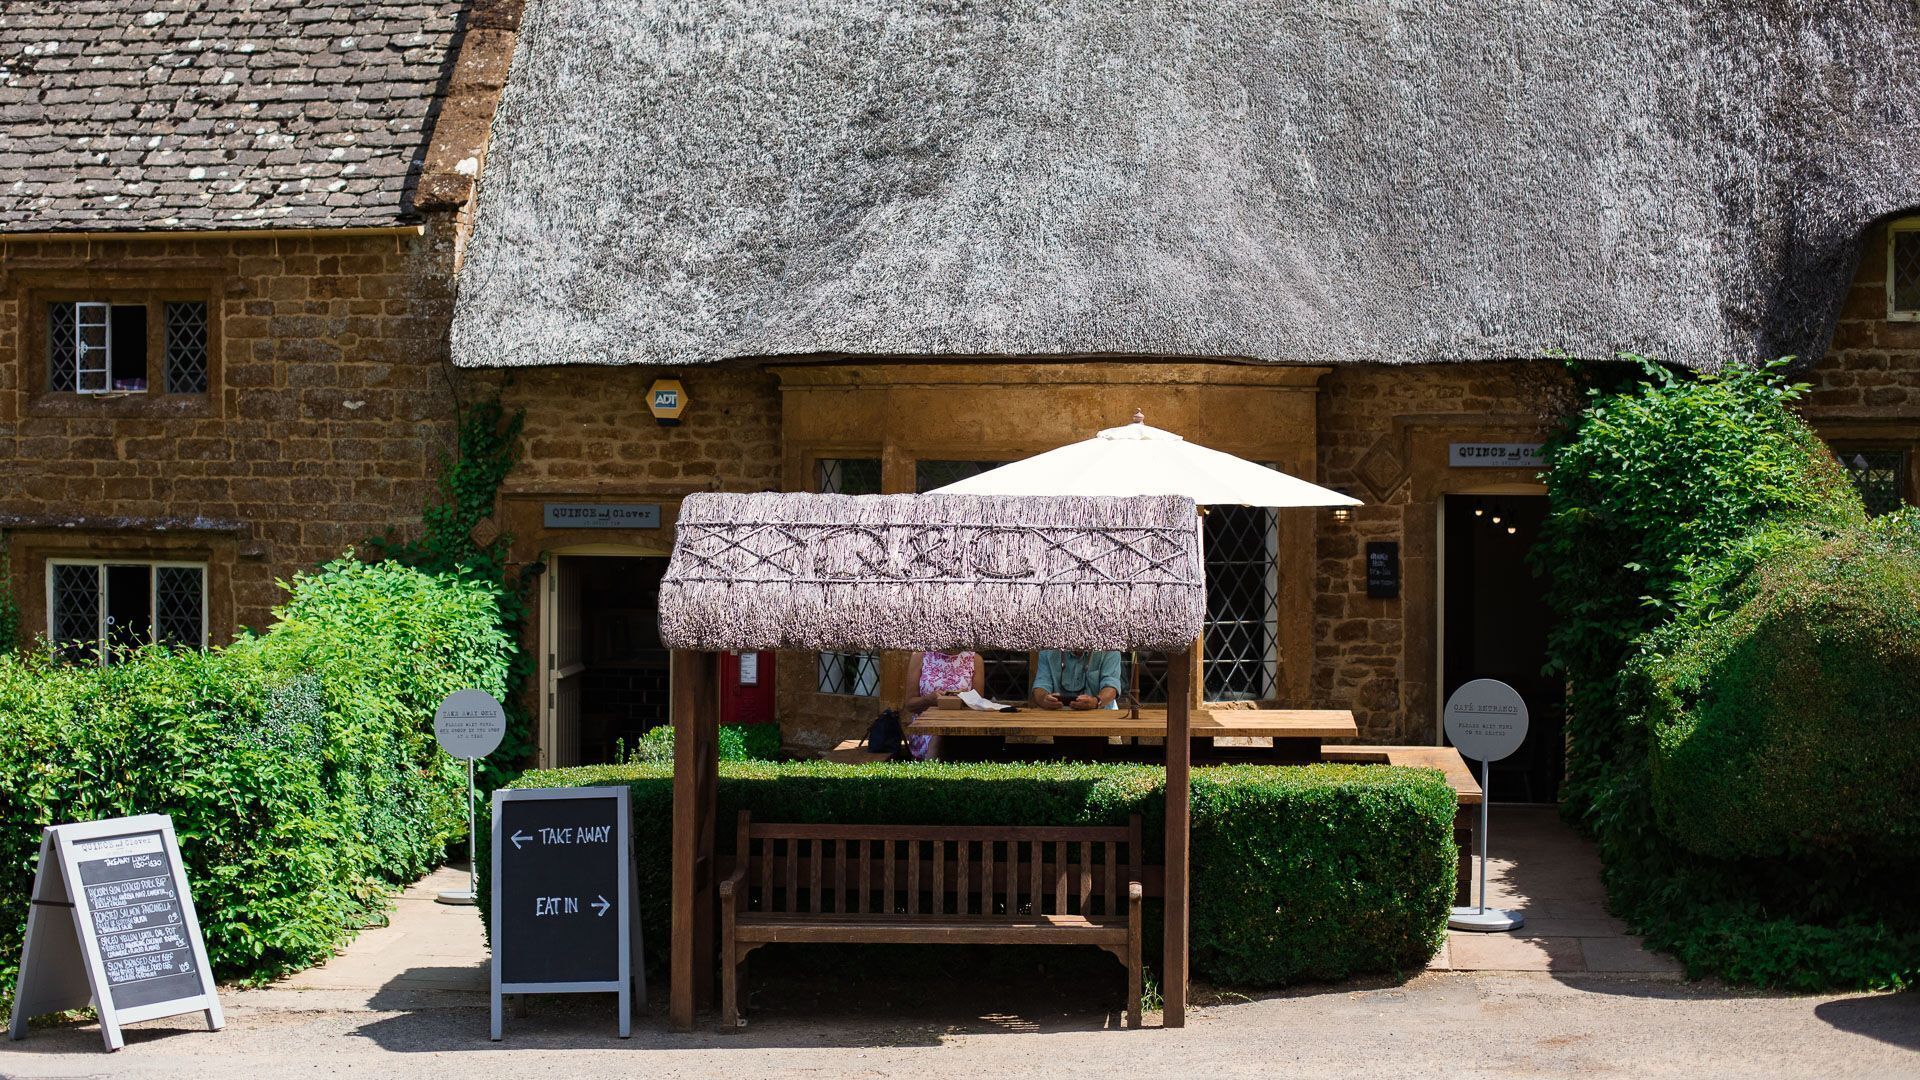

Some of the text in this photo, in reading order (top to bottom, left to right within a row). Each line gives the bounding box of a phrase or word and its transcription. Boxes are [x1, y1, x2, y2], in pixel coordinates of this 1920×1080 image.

[656, 394, 678, 404] ADT
[1459, 447, 1506, 458] QUINCE
[1508, 448, 1521, 460] and
[552, 508, 651, 520] QUINCE and Clover
[1454, 702, 1474, 711] CAFÉ
[538, 826, 610, 846] TAKE AWAY
[118, 907, 140, 917] SALMON
[536, 896, 578, 916] EAT IN
